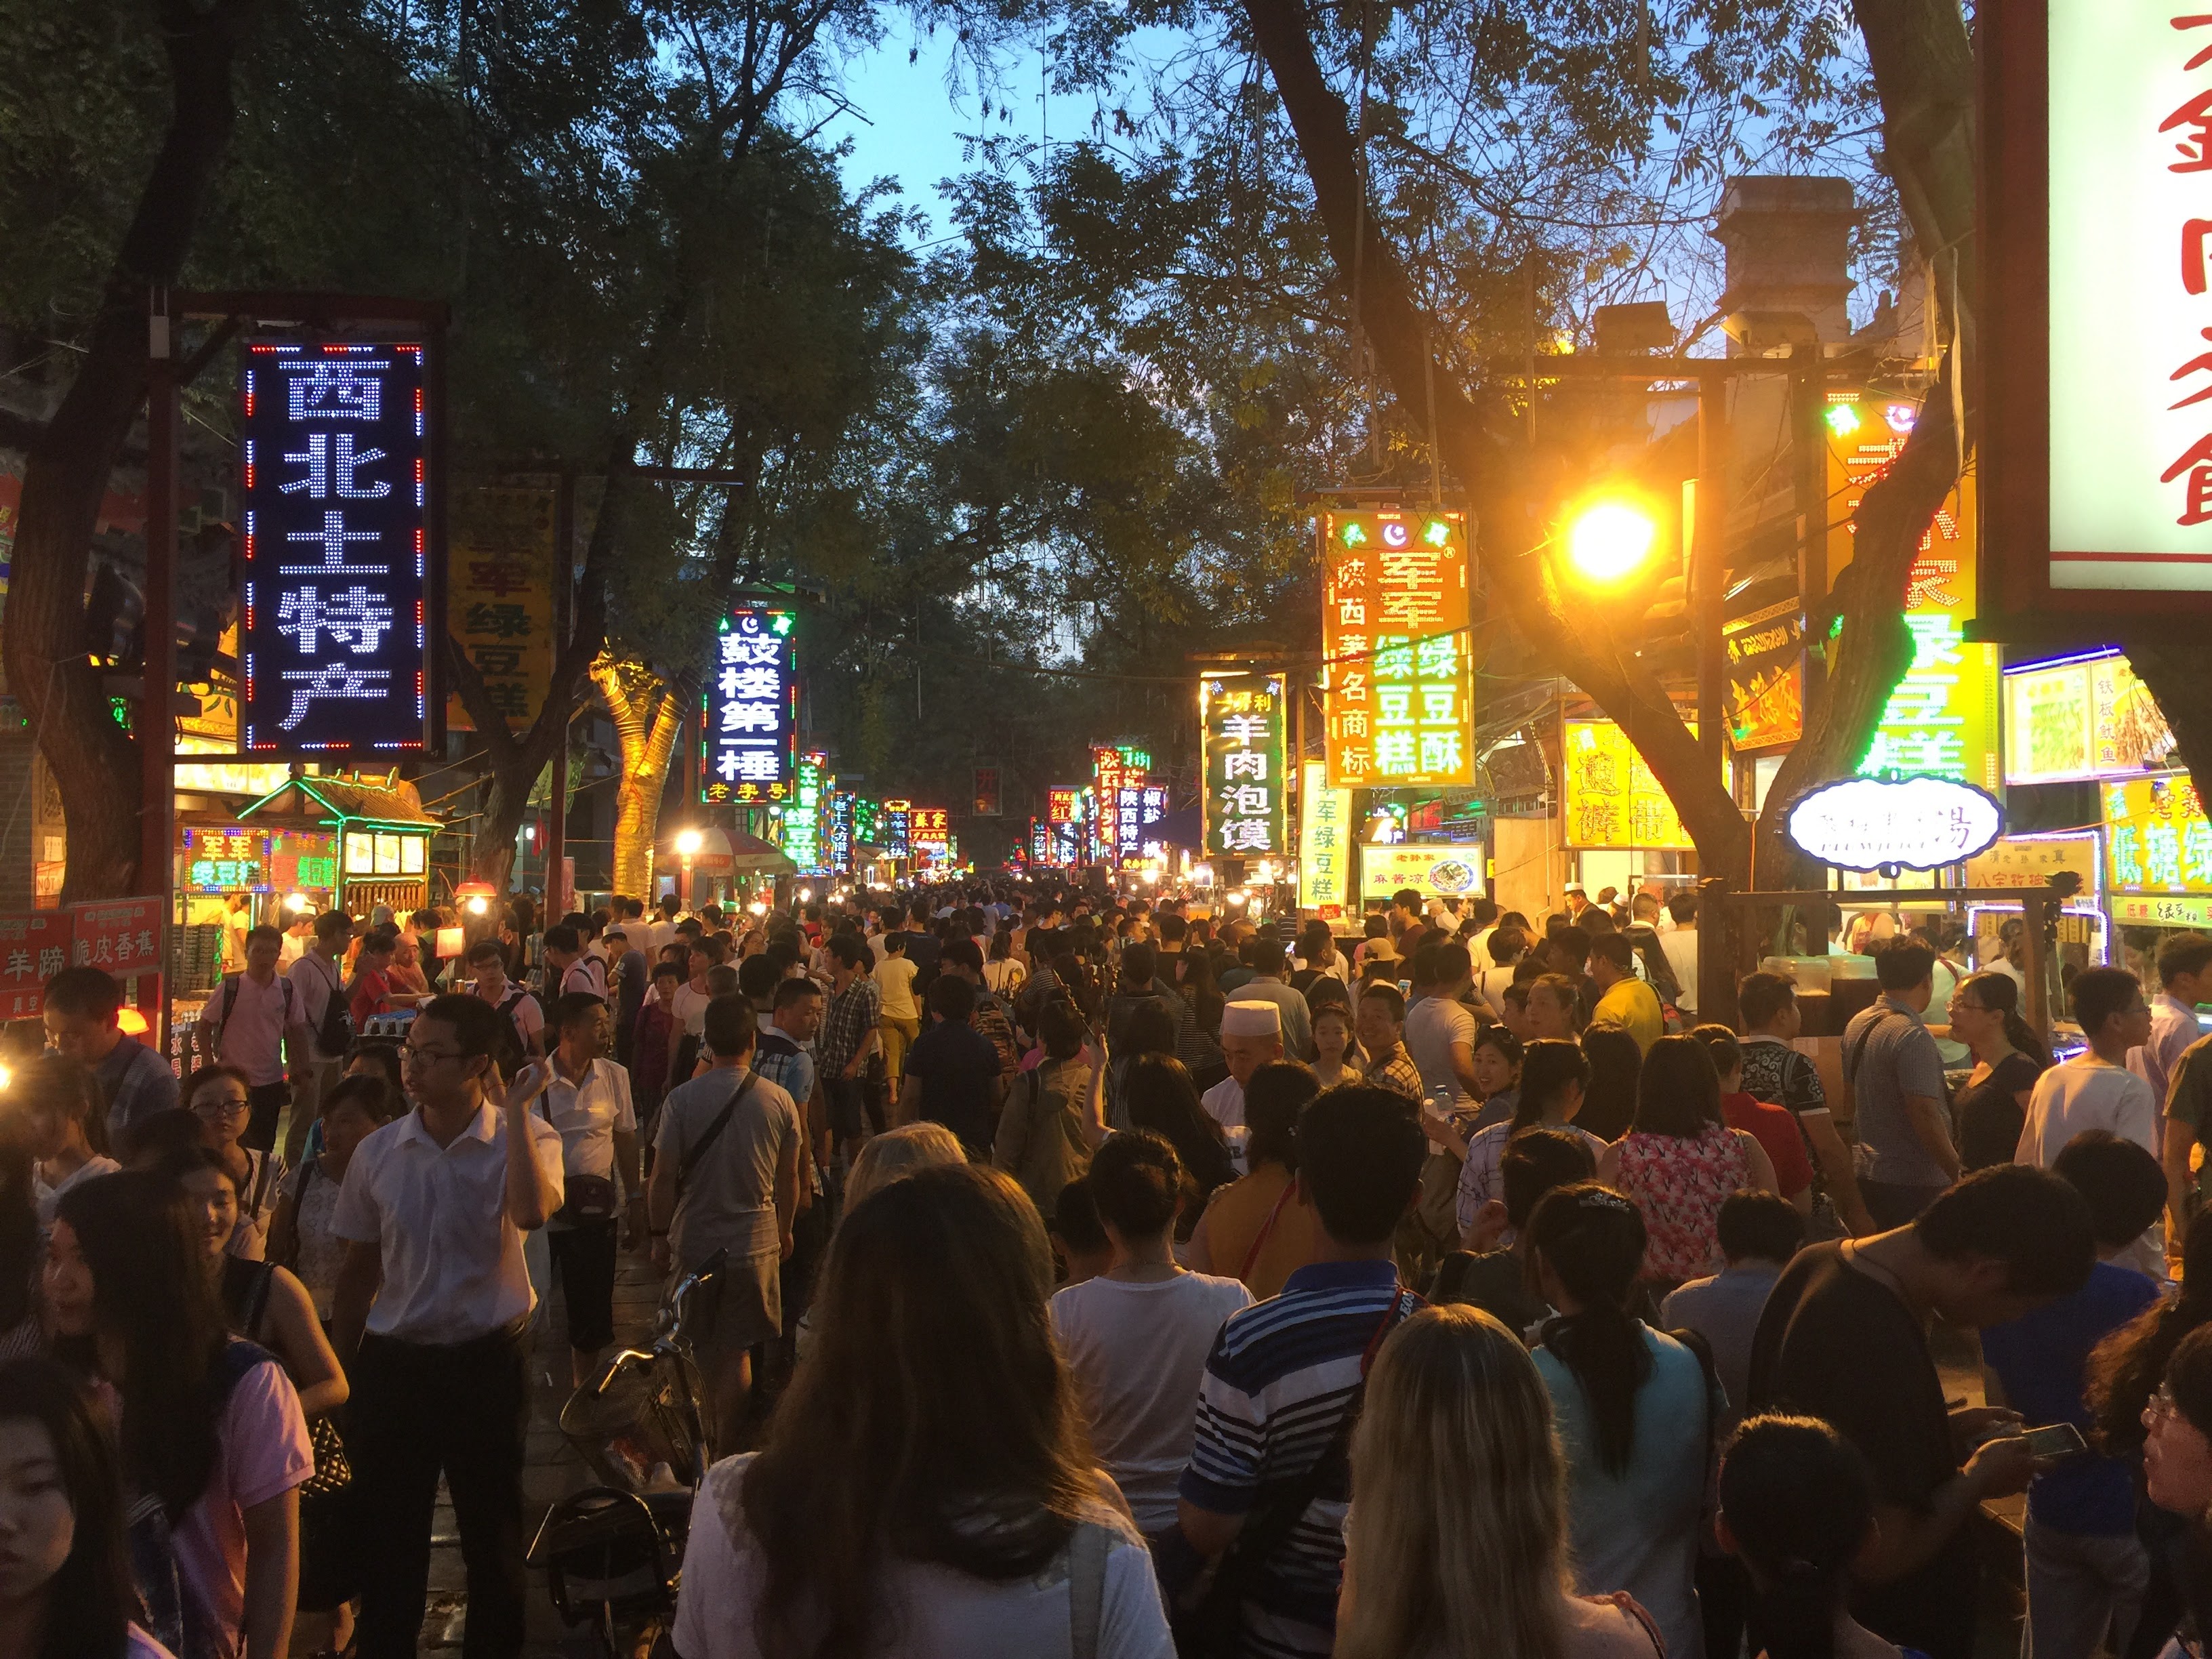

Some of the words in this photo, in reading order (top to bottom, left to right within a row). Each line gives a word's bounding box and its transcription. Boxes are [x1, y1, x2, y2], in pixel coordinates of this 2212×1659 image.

[276, 361, 394, 731] 西北土特产
[1378, 552, 1444, 629] 军军
[1374, 634, 1416, 775] 绿豆糕
[1417, 634, 1462, 774] 绿豆酥
[2097, 679, 2116, 763] 铁板鱿鱼
[709, 783, 787, 800] 老字号
[1219, 714, 1272, 851] 羊肉泡馍
[1120, 790, 1139, 859] 陕西特产
[1576, 798, 1692, 842] 裤带
[201, 836, 251, 861] 军军
[1397, 853, 1436, 862] 老孙家
[37, 877, 56, 891] NOT
[192, 860, 260, 886] 绿豆糕
[1373, 873, 1443, 884] 麻酱凉皮
[2127, 903, 2149, 918] 低糖
[4, 945, 66, 982] 羊蹄
[75, 928, 155, 967] 脆皮香蕉
